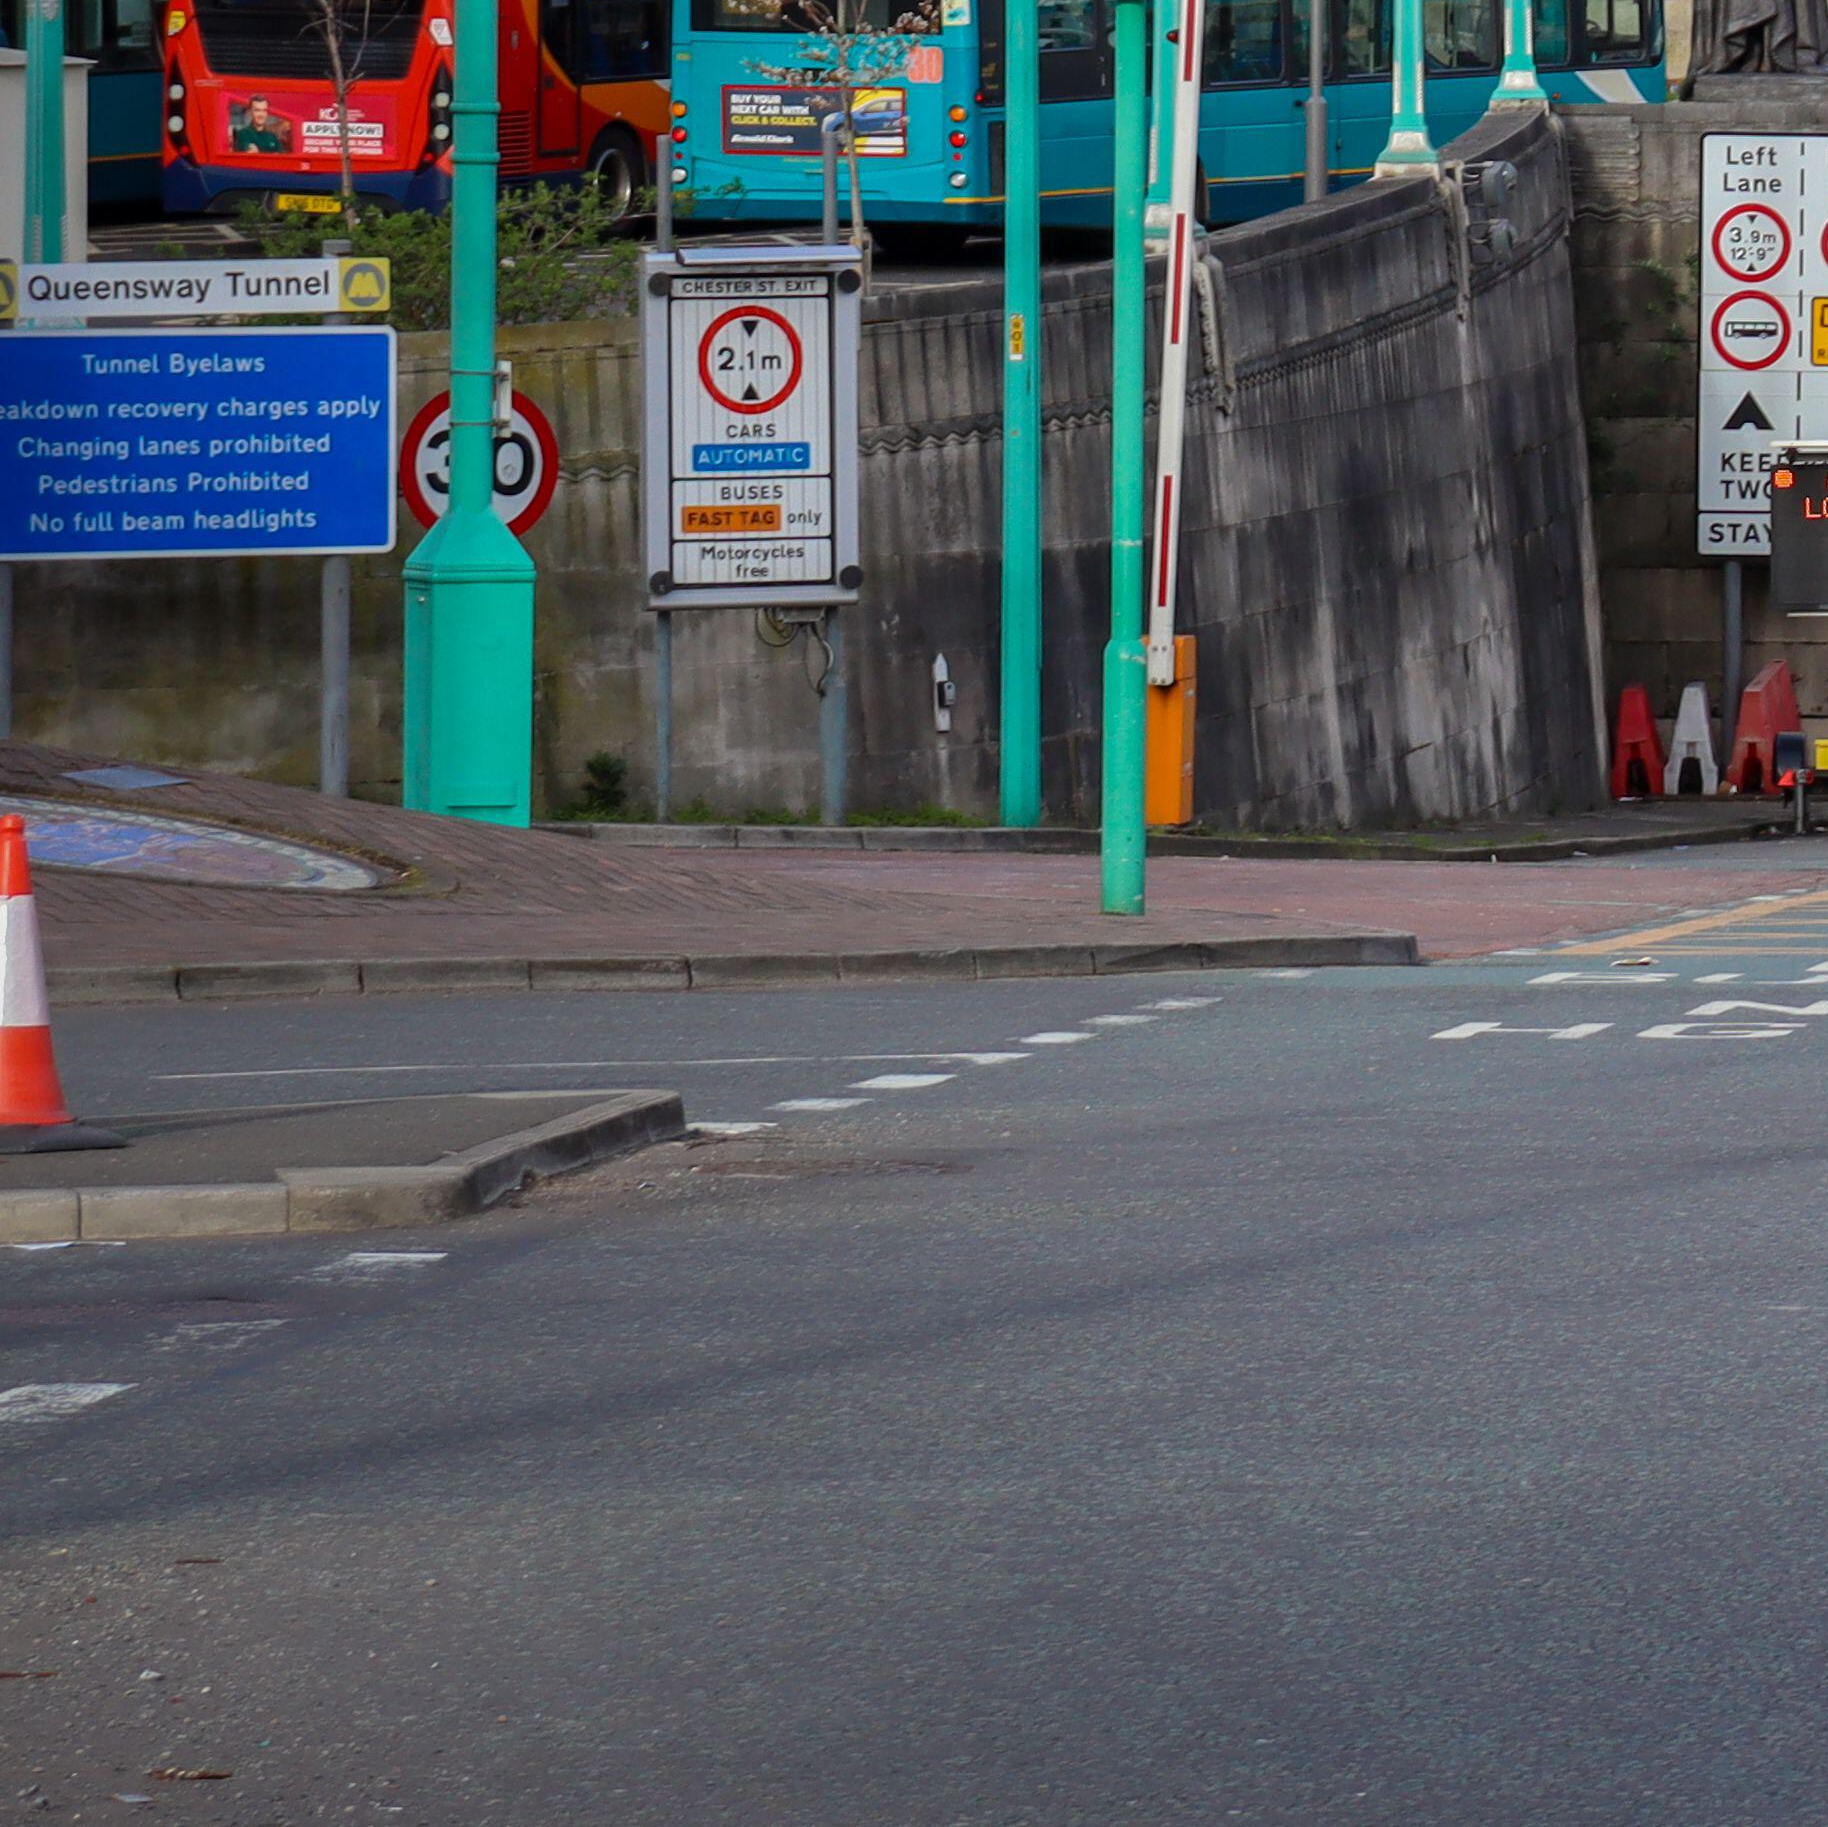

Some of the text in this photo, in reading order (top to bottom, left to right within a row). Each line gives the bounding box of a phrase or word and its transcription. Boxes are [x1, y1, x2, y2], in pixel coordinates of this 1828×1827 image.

[1726, 146, 1777, 166] Left
[1724, 173, 1782, 193] Lane
[27, 270, 330, 303] Queensway Tunnel
[682, 280, 817, 293] CHESTER ST. EXIT
[82, 353, 266, 377] Tunnel Byelaws
[108, 401, 209, 421] recovery
[217, 396, 308, 420] charges
[317, 395, 380, 420] apply
[726, 424, 777, 439] CARS
[18, 433, 331, 461] Changing lanes prohibited
[697, 448, 805, 465] AUTOMATIC
[39, 471, 309, 496] Pedestrians Prohibited
[720, 485, 784, 500] BUSES
[30, 508, 318, 533] No full beam headlights
[687, 510, 822, 526] FAST TAG only
[1709, 523, 1772, 544] STAY
[701, 545, 805, 562] Motorcycles
[736, 565, 769, 577] free
